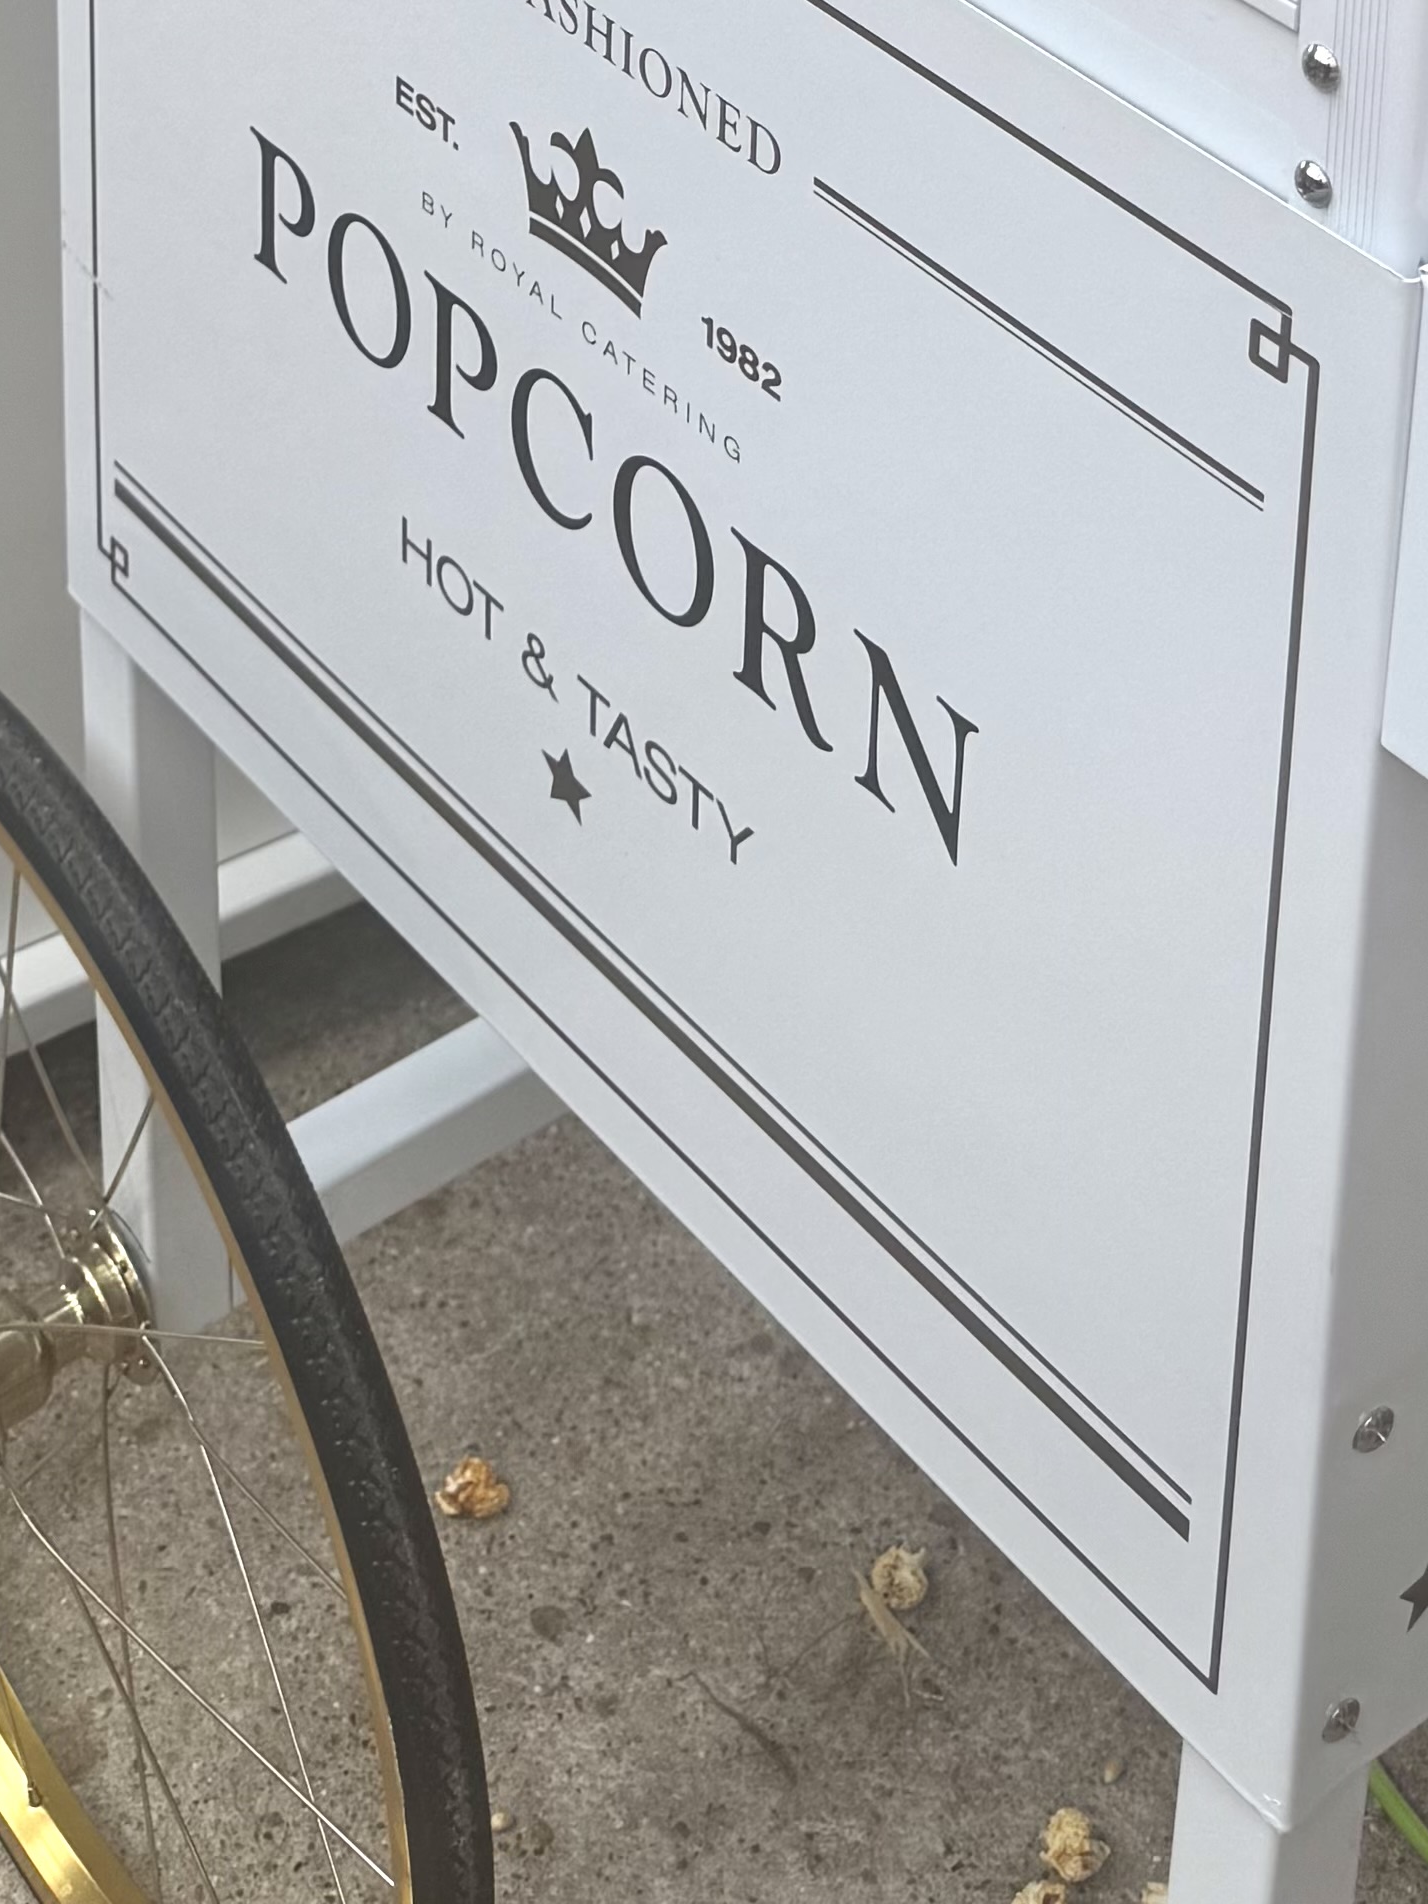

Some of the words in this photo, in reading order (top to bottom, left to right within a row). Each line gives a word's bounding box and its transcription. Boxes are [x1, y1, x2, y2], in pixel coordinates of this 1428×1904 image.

[394, 74, 460, 152] EST.
[420, 190, 454, 229] BY
[470, 229, 563, 321] ROYAL
[580, 320, 741, 465] CATERING
[699, 315, 783, 403] 1982
[247, 124, 980, 868] POPCORN
[400, 514, 505, 642] HOT
[519, 631, 560, 705] &
[575, 672, 756, 866] TASTY
